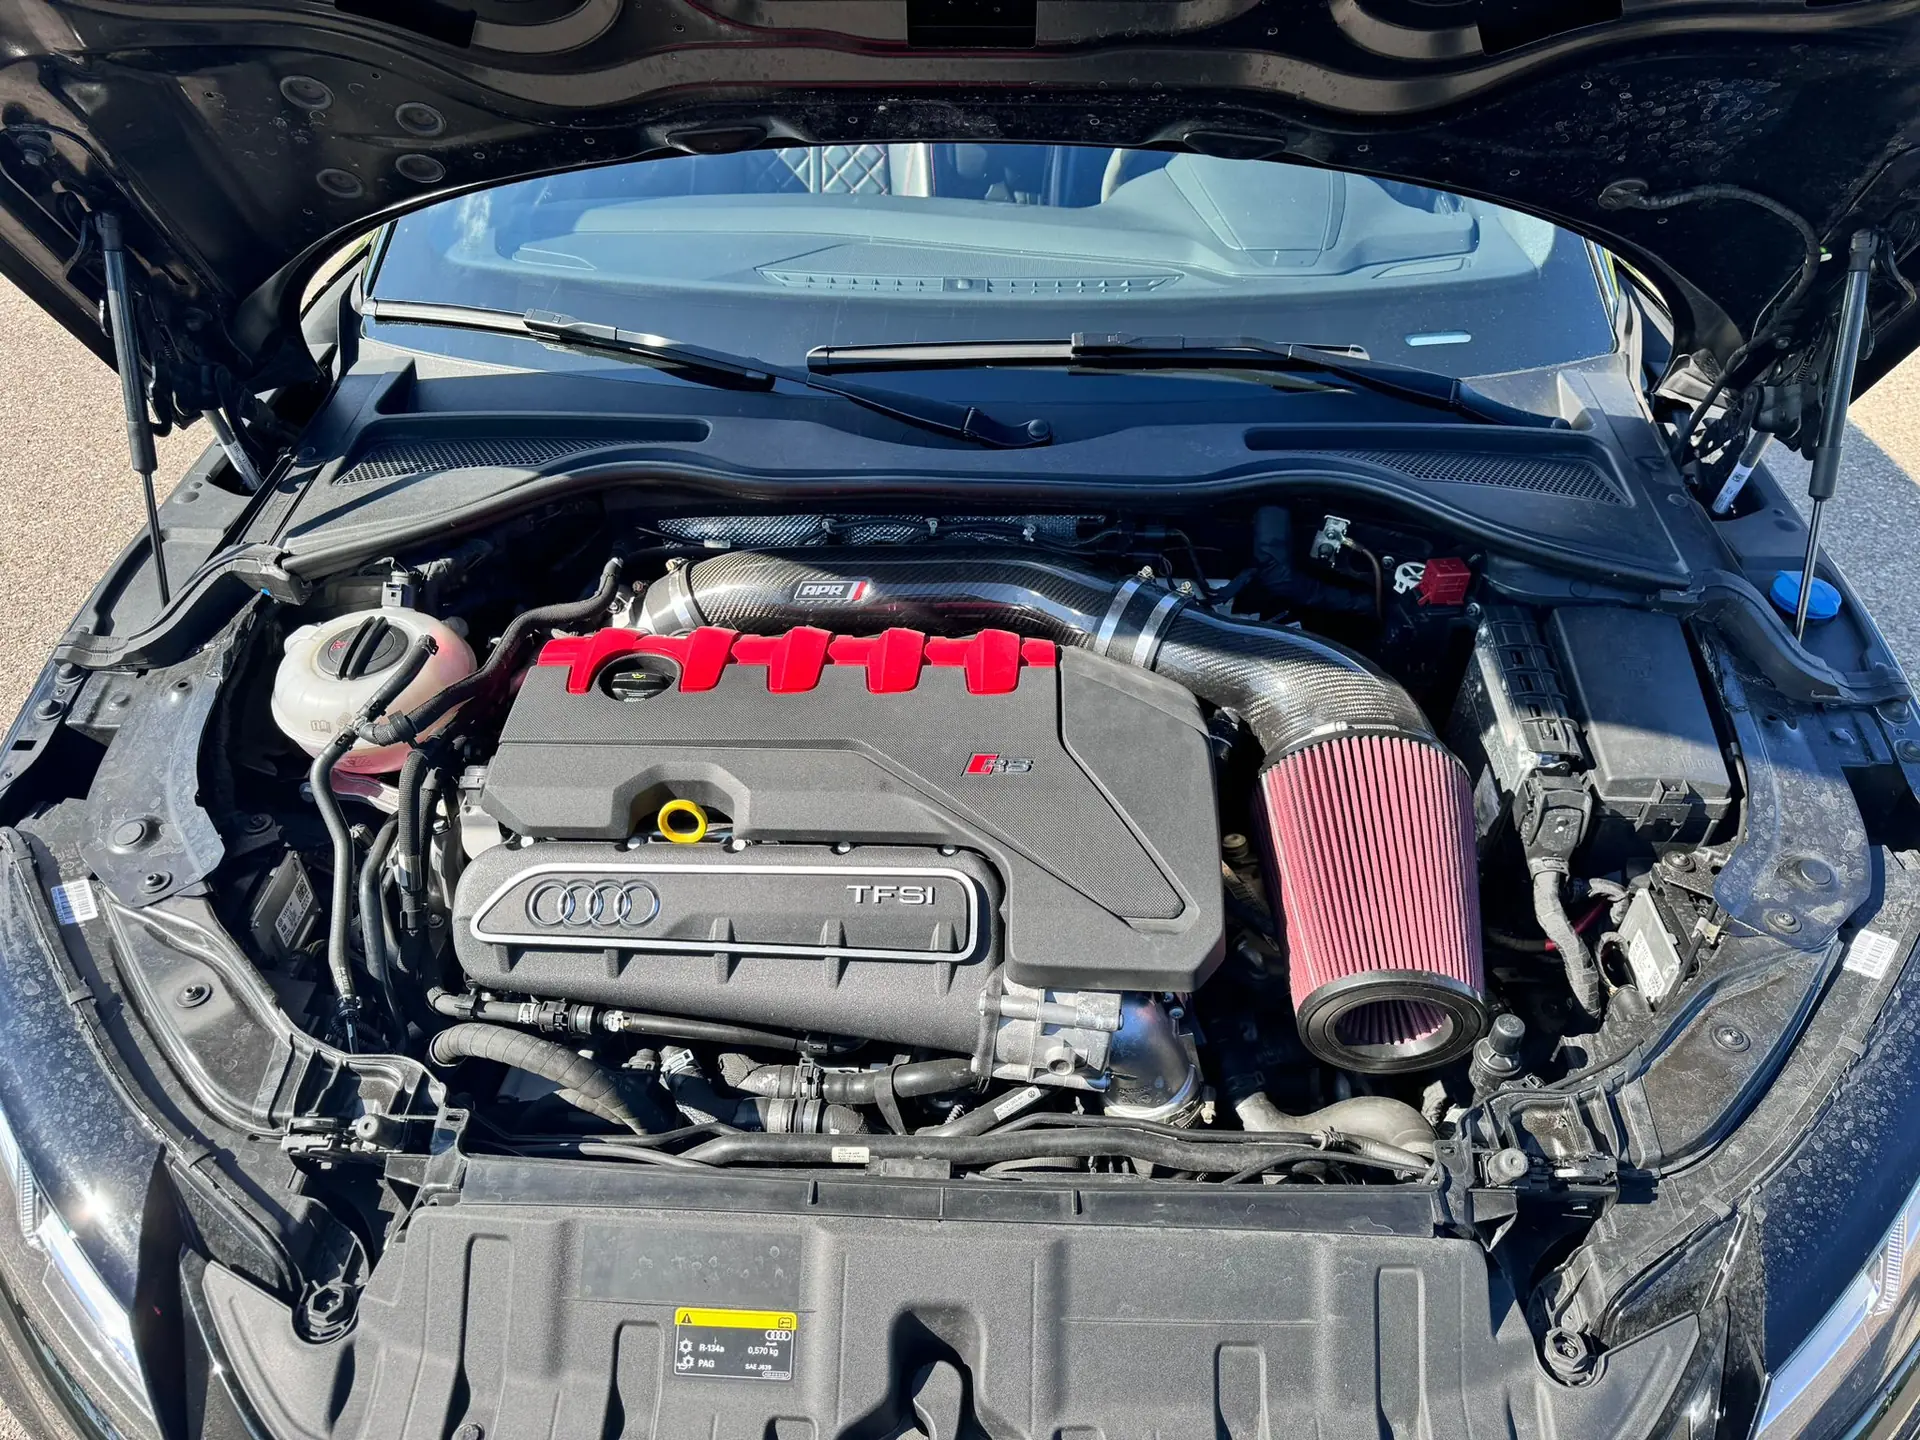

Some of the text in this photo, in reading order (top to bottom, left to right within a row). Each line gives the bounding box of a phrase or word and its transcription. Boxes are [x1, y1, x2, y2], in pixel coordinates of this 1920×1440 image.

[801, 585, 845, 596] APR
[846, 885, 936, 906] TFSI
[699, 1343, 725, 1353] R-134a
[747, 1346, 779, 1357] 0,570 kg
[698, 1359, 716, 1368] PAG
